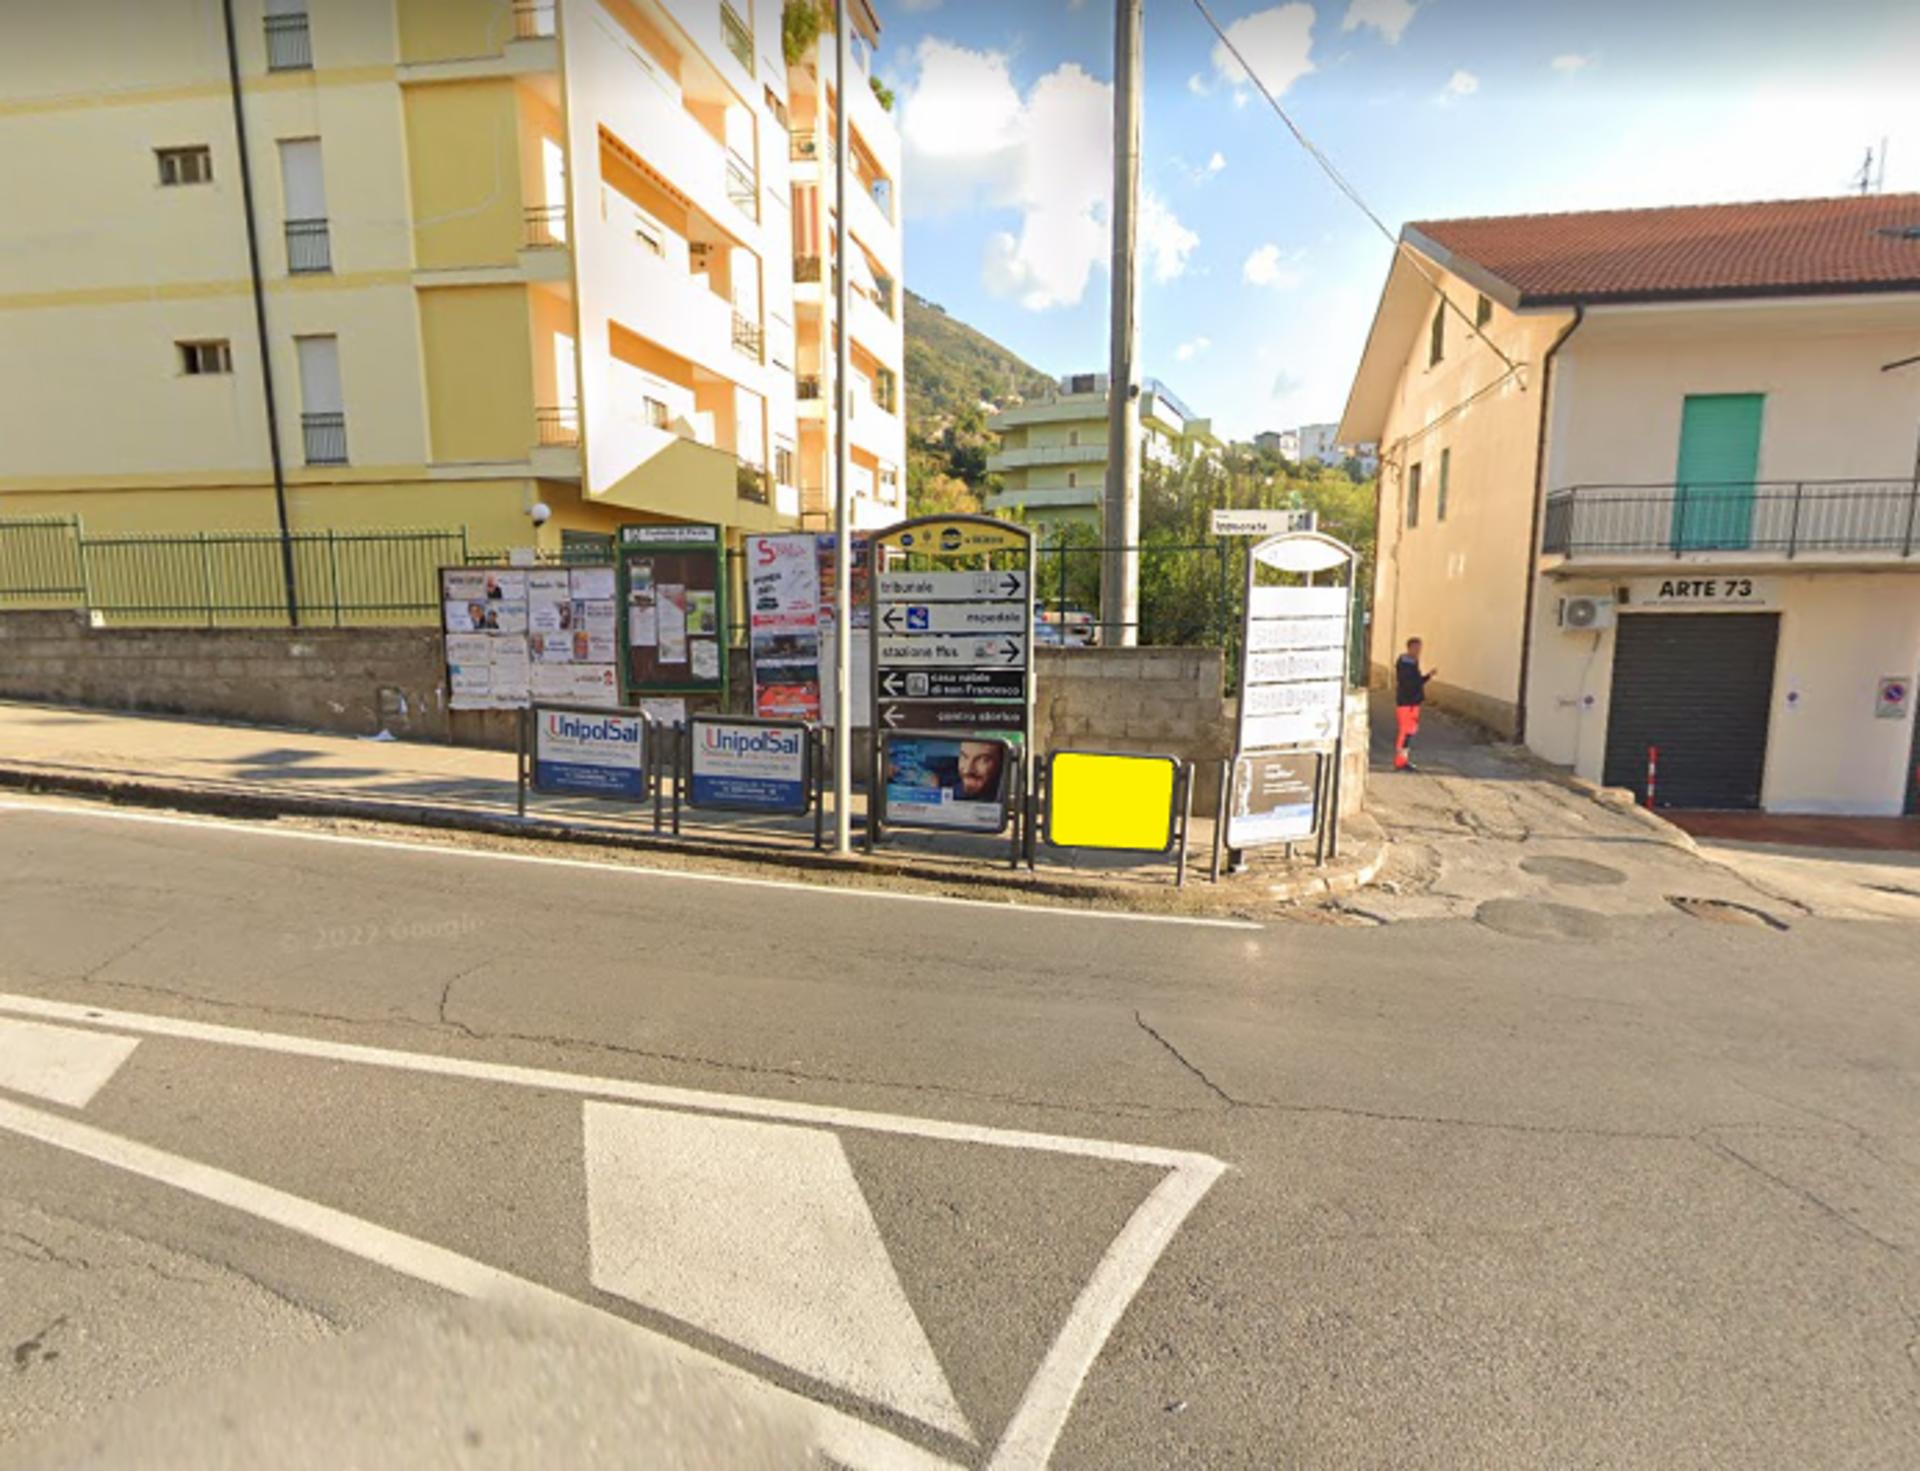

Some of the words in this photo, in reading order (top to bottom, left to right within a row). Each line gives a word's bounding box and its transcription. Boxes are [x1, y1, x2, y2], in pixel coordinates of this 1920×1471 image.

[881, 580, 933, 593] tribunale
[1659, 580, 1716, 597] ARTE
[1725, 579, 1752, 597] 73
[966, 612, 1021, 623] ospedale
[883, 646, 932, 657] stazione
[930, 673, 956, 682] casa
[958, 673, 991, 682] natale
[930, 685, 943, 695] di
[944, 686, 964, 695] san
[966, 684, 1020, 696] Francesco
[937, 711, 976, 721] centro
[978, 711, 1021, 721] storico
[548, 714, 639, 744] UnipolSai
[704, 728, 799, 757] UnipolSai
